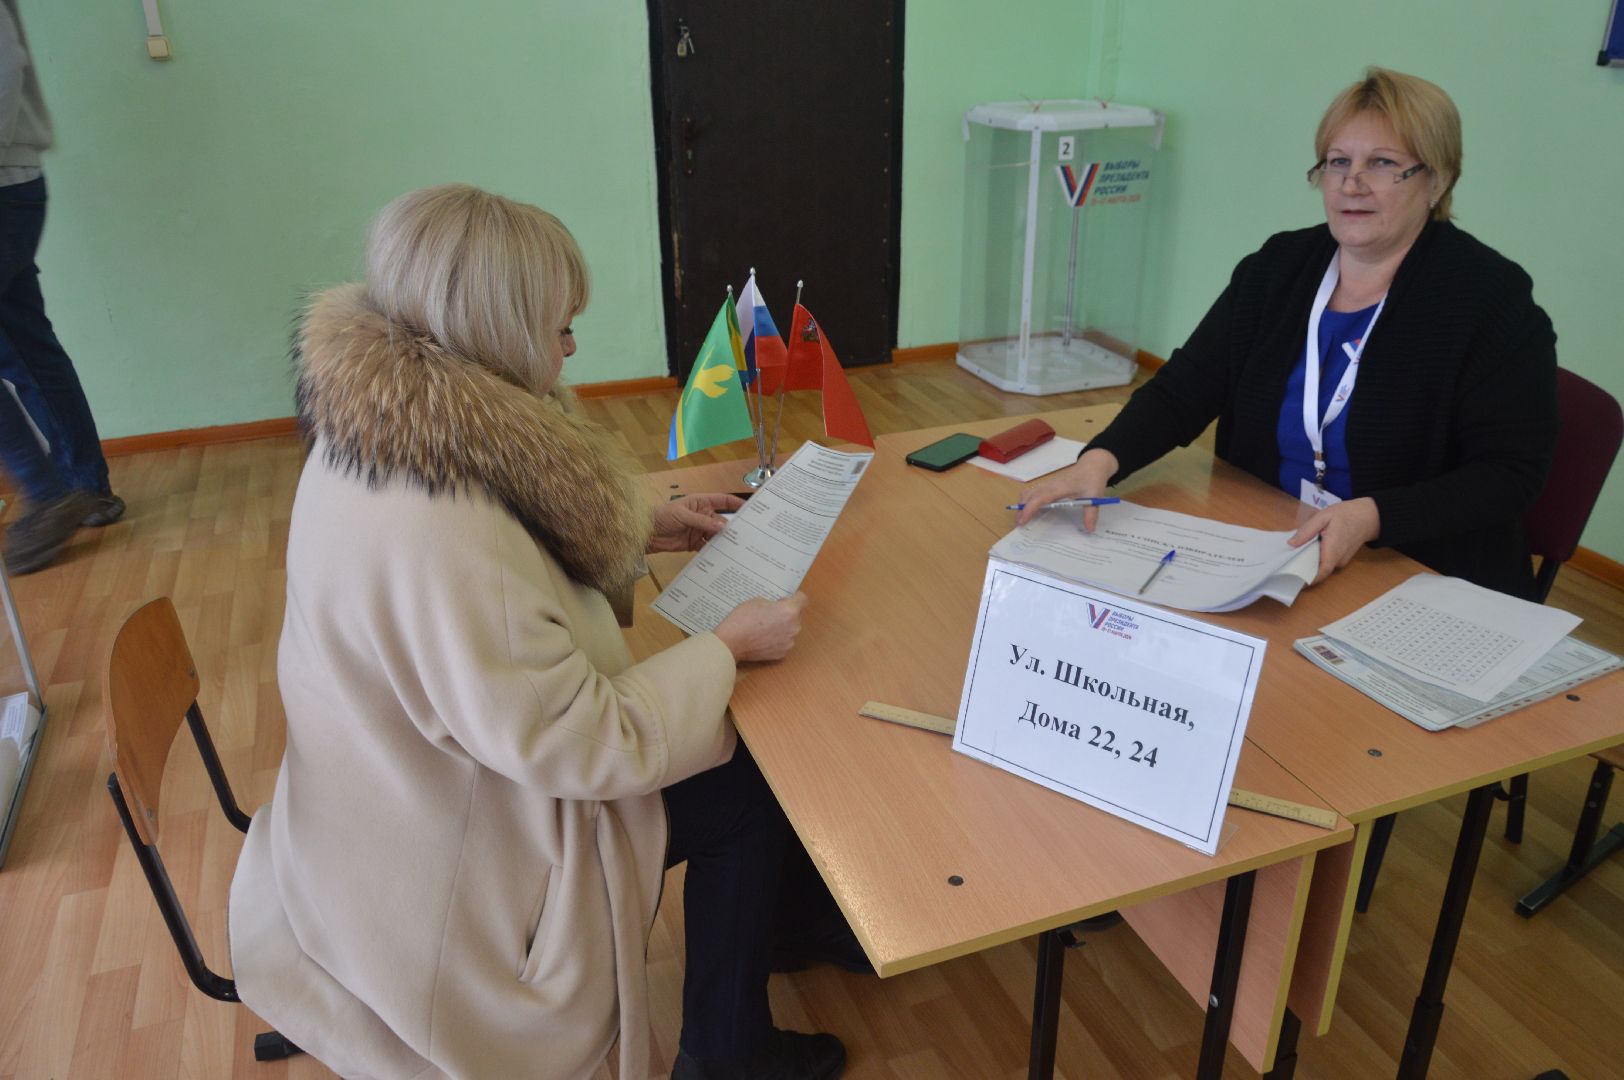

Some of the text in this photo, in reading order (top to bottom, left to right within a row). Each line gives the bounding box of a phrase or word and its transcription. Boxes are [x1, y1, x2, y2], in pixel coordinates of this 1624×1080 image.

[1062, 142, 1071, 156] 2
[1104, 160, 1141, 171] ВЫБОРЫ
[1099, 170, 1150, 183] ПРЕЗИДЕНТА
[1093, 185, 1127, 196] РОССИИ
[1111, 610, 1135, 621] ВЫБОРЫ
[1009, 644, 1195, 731] Ул. Школьная,
[1018, 700, 1158, 768] Дома 22, 24
